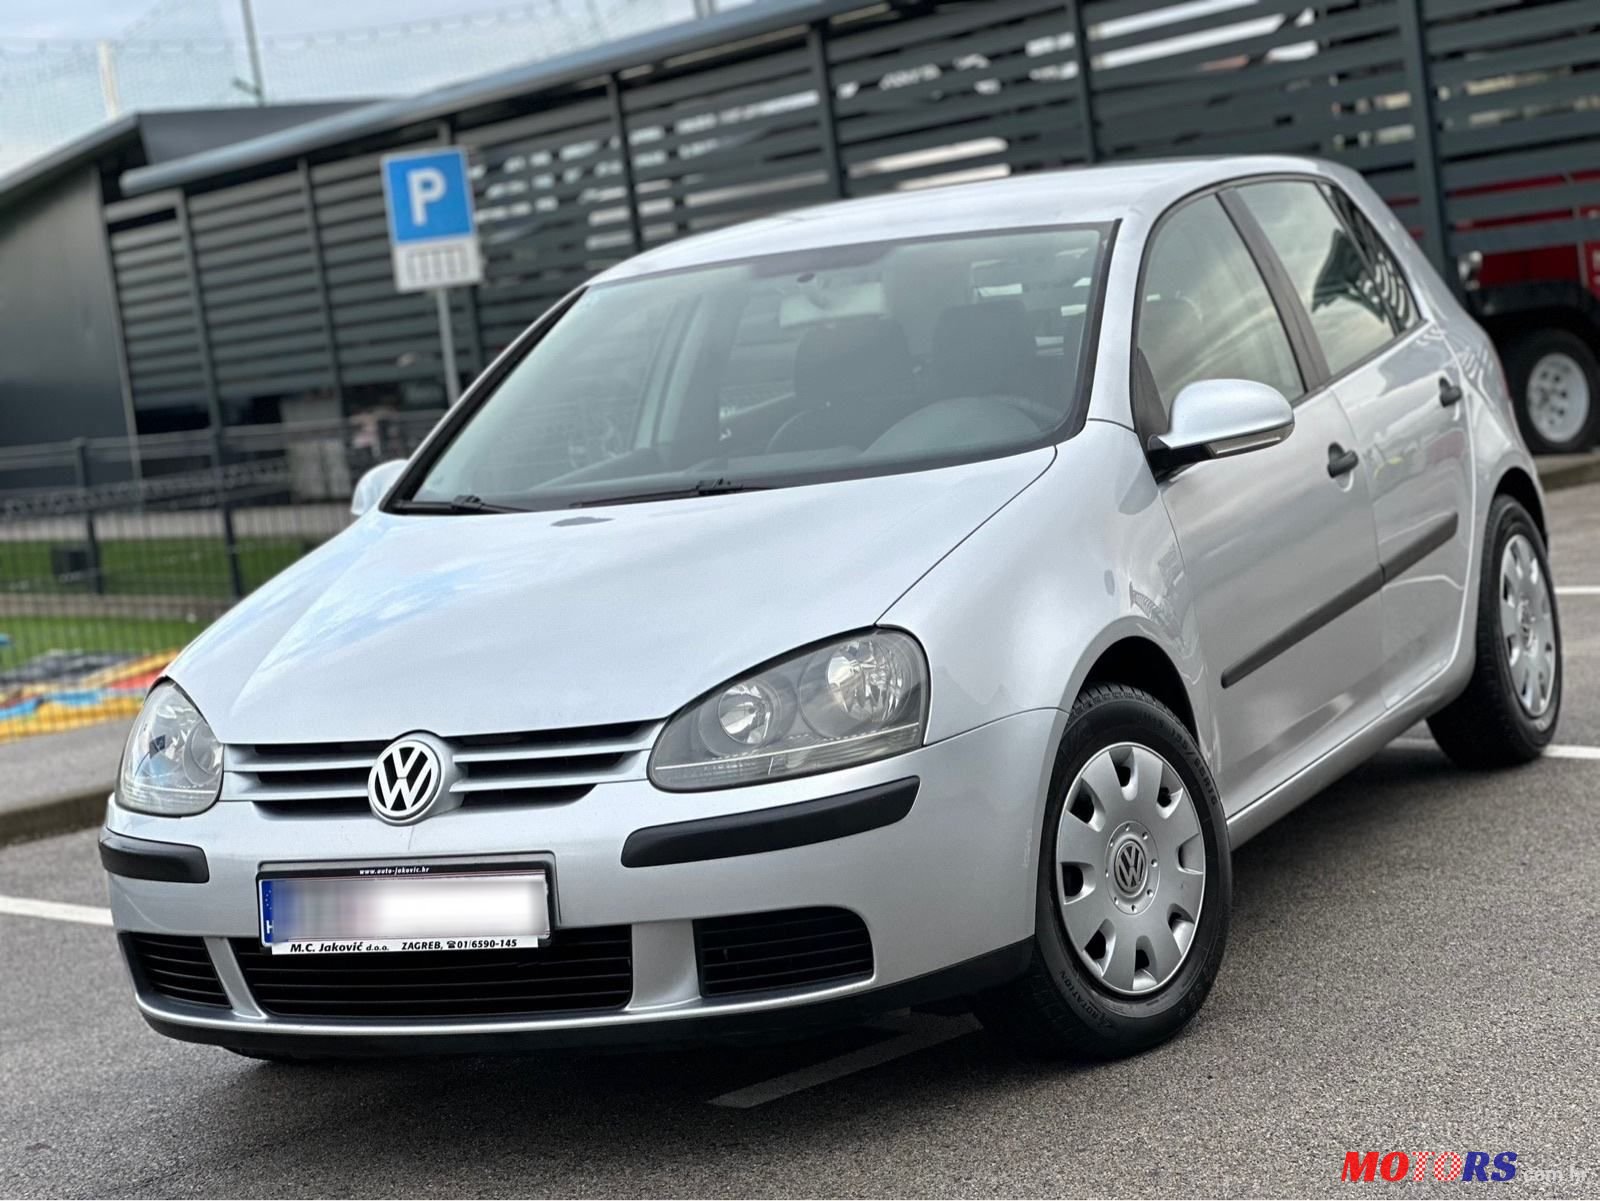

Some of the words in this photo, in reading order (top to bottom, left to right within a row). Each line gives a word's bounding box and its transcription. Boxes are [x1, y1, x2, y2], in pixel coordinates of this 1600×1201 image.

[406, 167, 447, 227] P
[368, 740, 440, 818] VW
[359, 866, 431, 877] www.auto-jakovic.hr
[1114, 839, 1147, 894] VW
[290, 943, 316, 953] M.C.
[318, 941, 362, 953] Jaković
[401, 941, 444, 951] ZAGREB,
